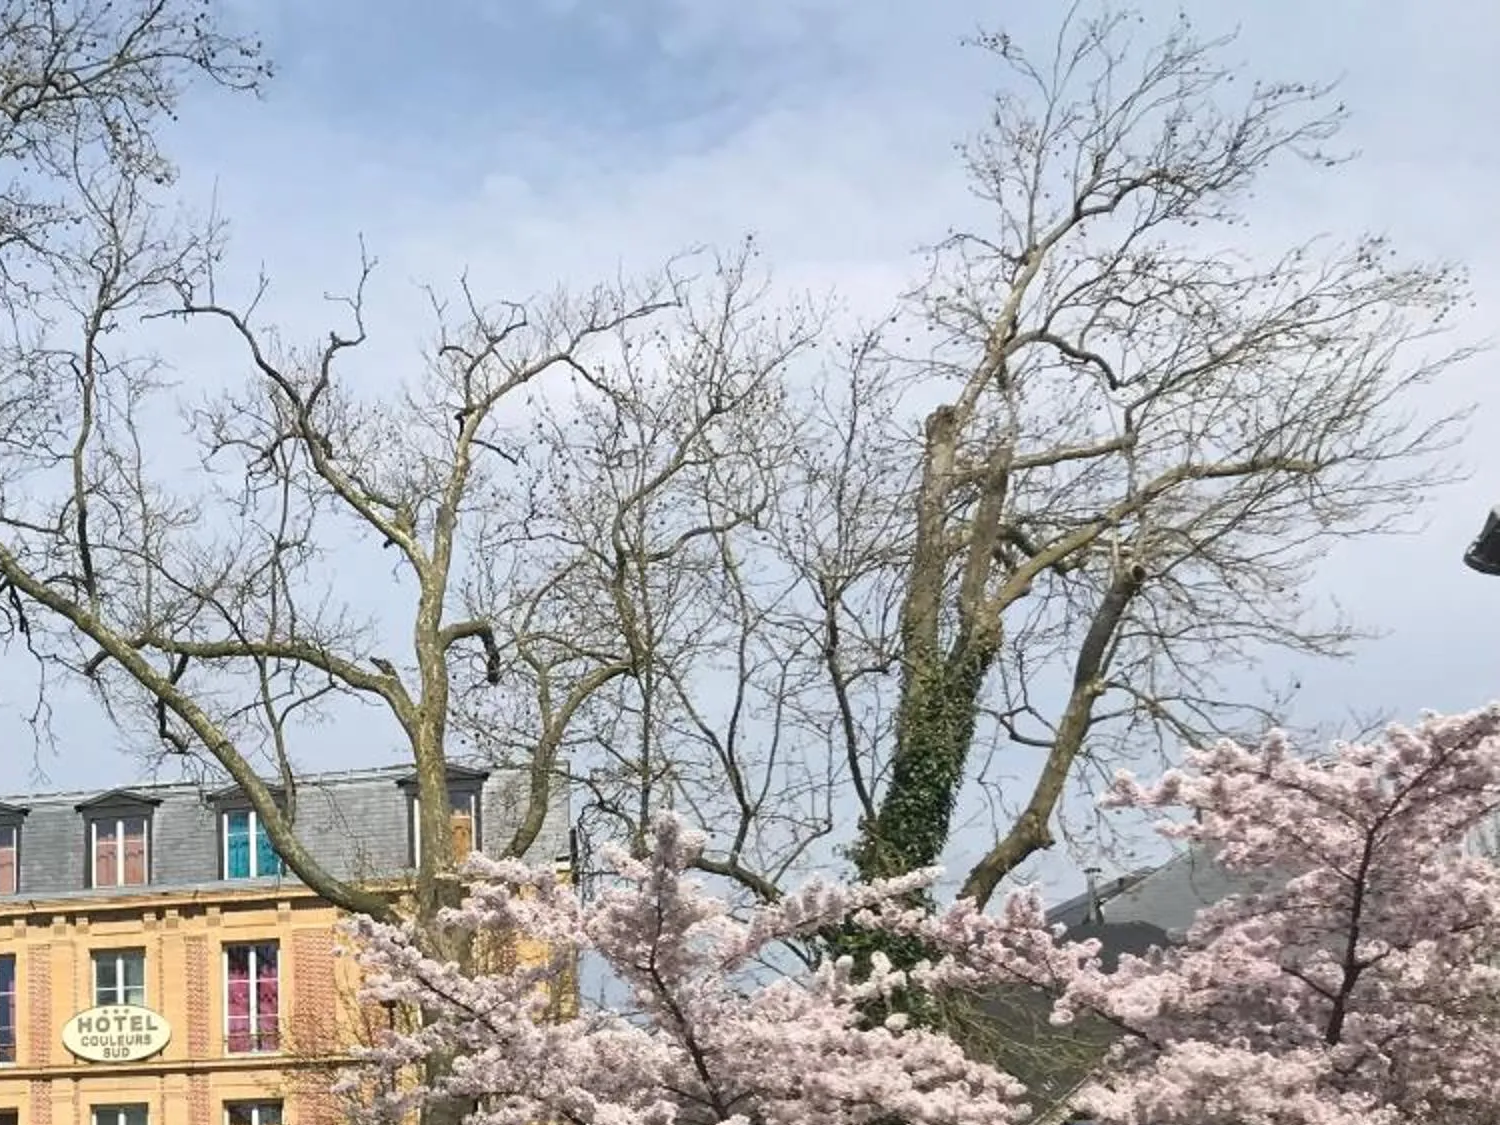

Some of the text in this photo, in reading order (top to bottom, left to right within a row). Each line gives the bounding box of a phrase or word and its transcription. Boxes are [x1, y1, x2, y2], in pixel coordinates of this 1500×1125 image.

[77, 1015, 158, 1033] HOTEL
[81, 1034, 152, 1047] COULEURS
[103, 1047, 130, 1058] SUD
